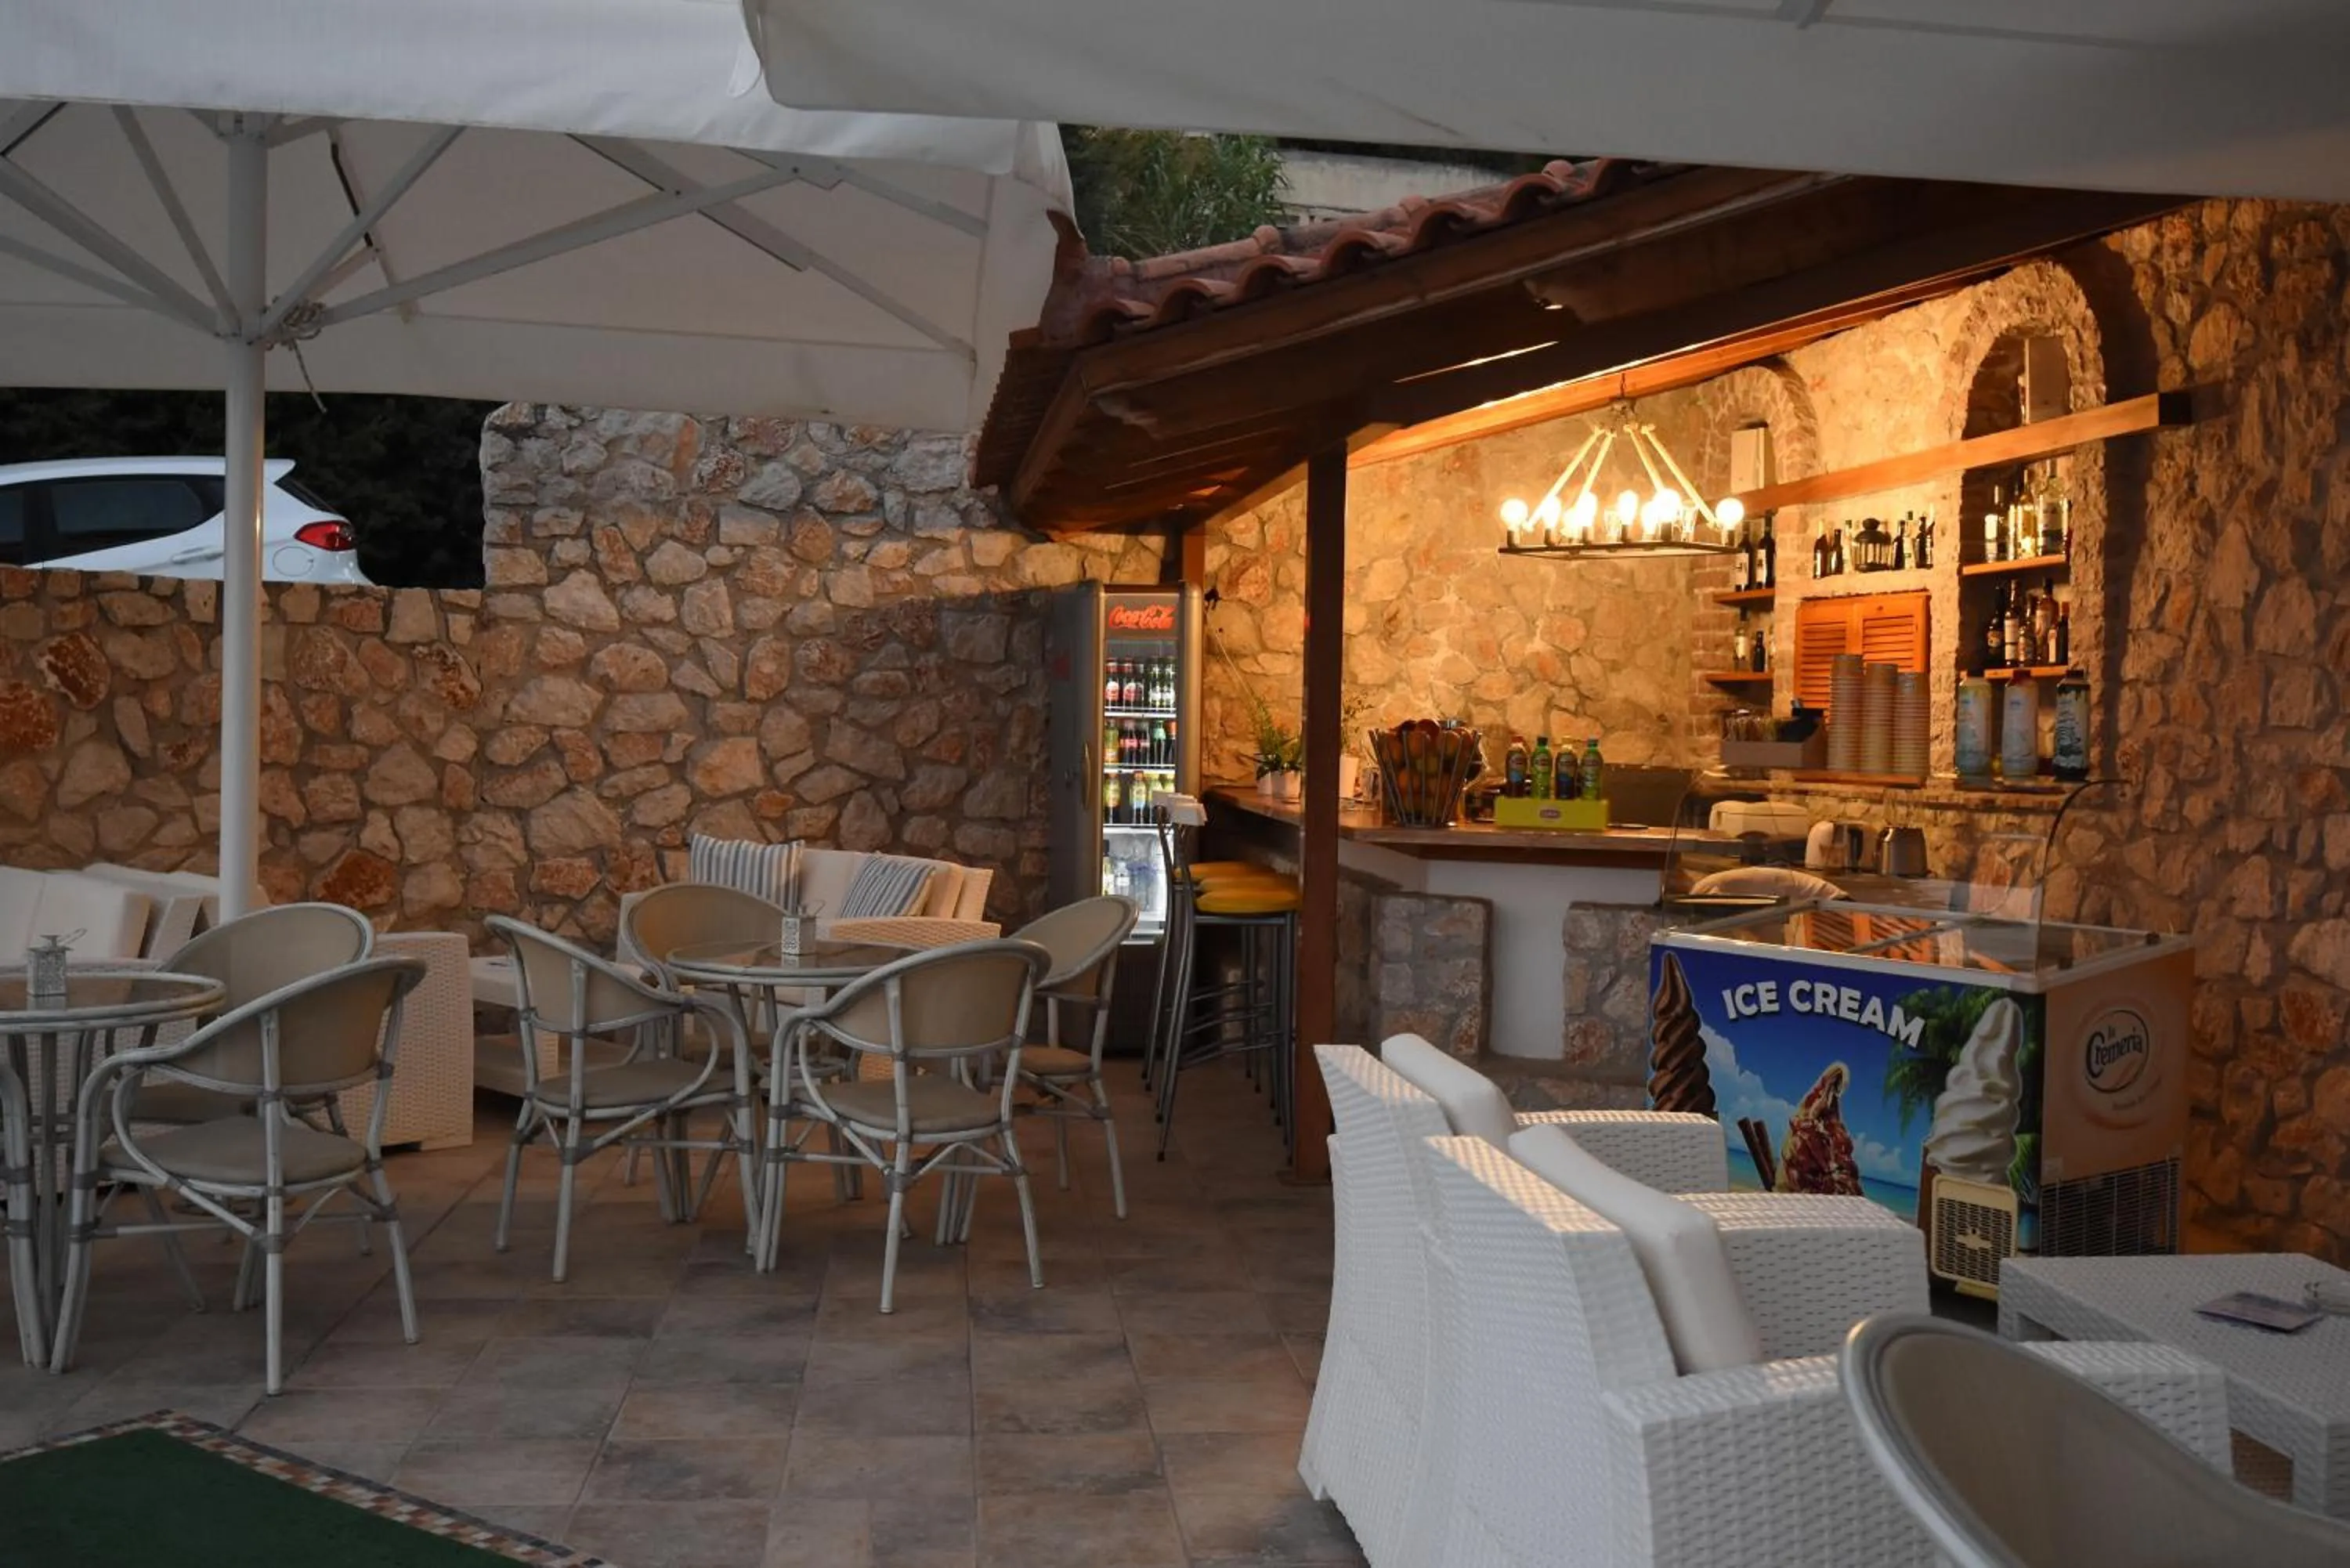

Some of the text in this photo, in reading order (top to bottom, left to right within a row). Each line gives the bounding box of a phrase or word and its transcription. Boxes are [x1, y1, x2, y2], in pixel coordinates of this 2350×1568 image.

[1722, 980, 1926, 1048] ICE CREAM
[2085, 1026, 2143, 1078] Cremeria
